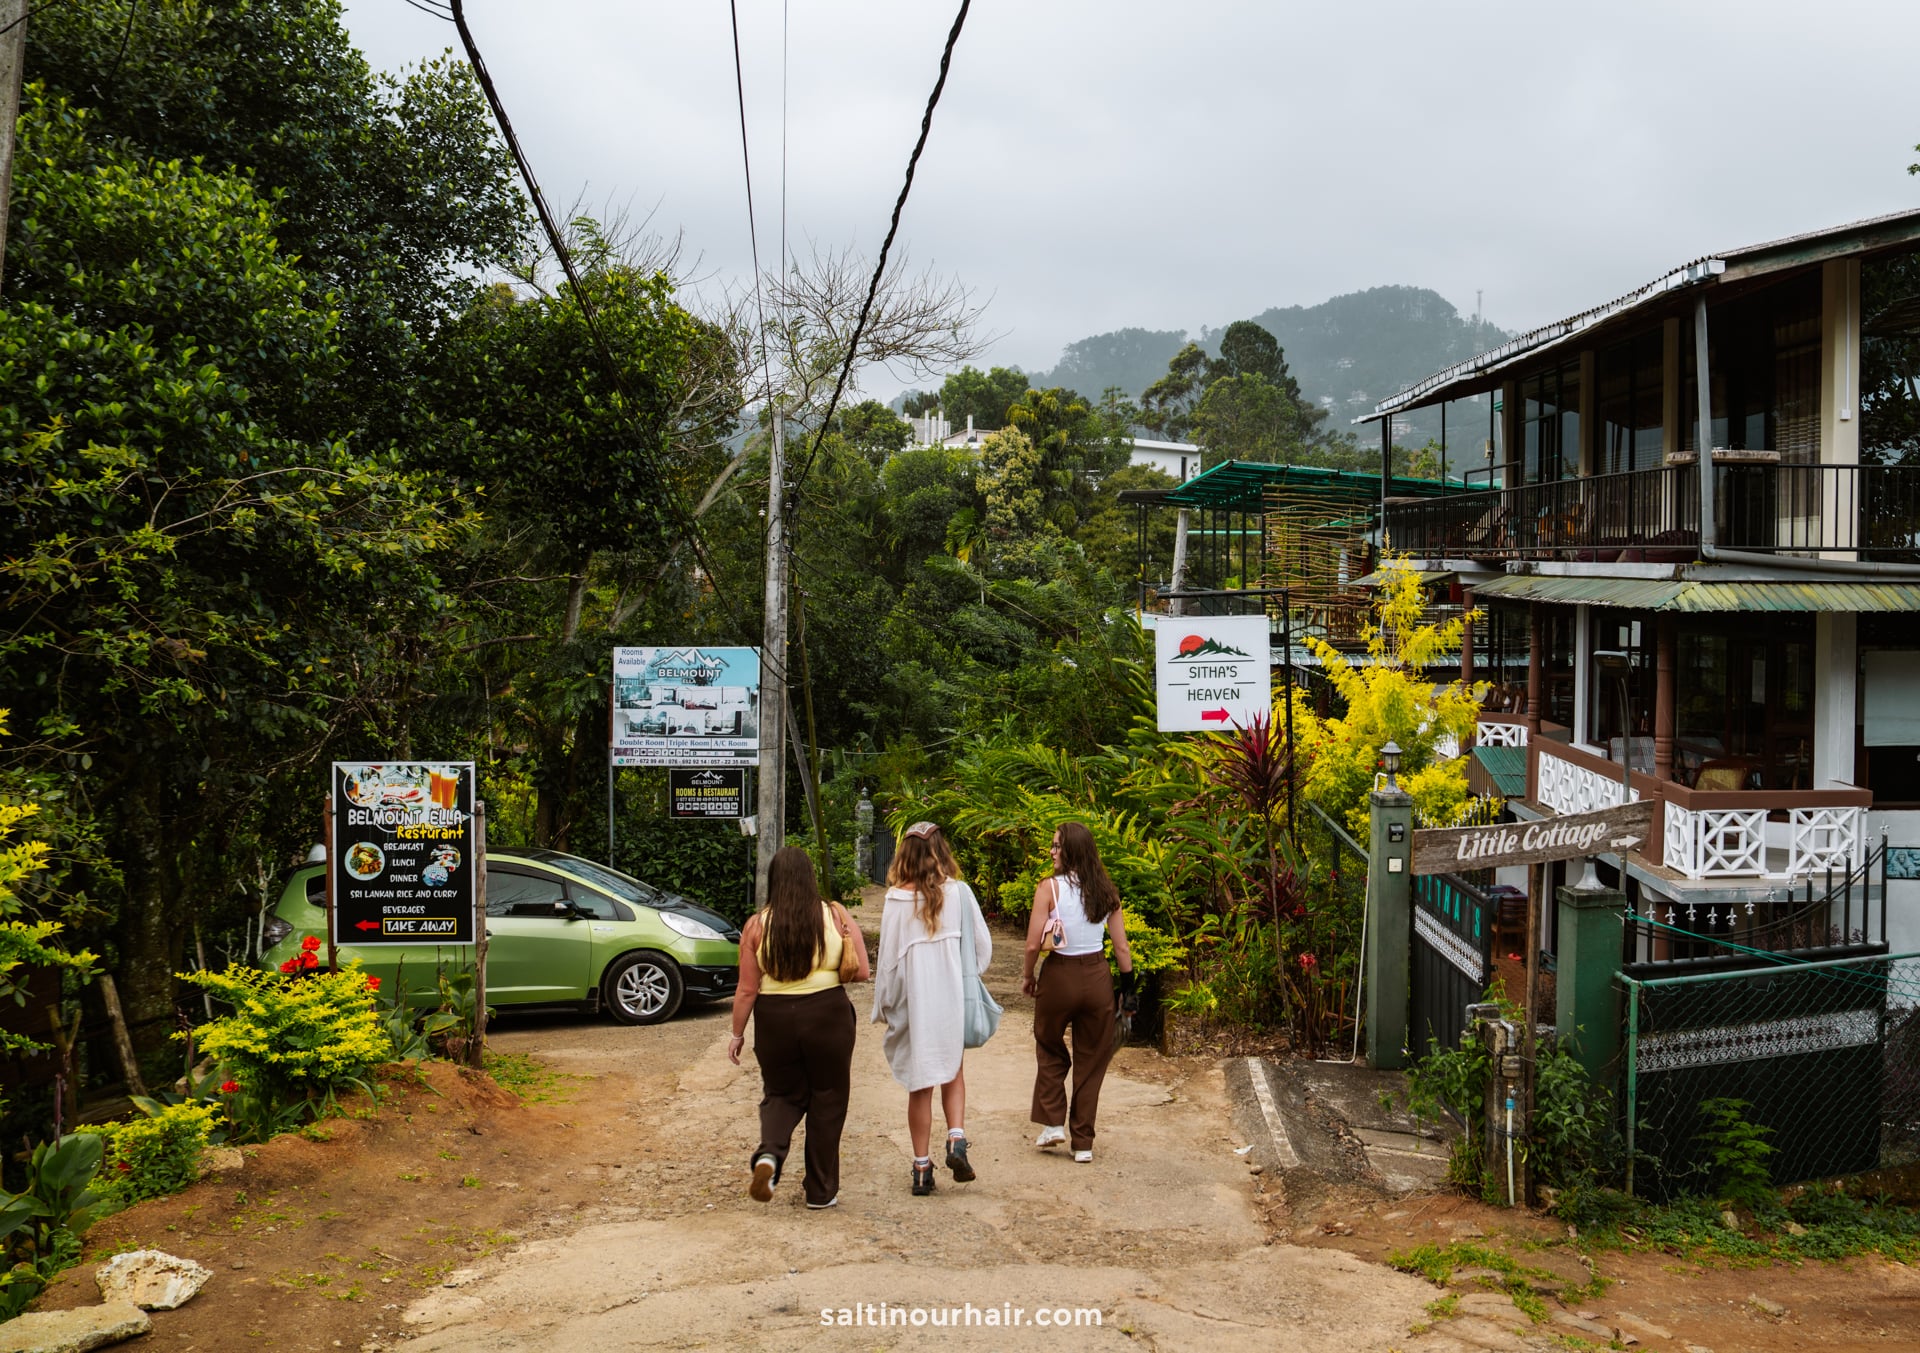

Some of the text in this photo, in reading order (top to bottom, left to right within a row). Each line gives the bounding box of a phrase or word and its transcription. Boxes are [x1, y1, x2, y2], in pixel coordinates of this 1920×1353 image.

[621, 648, 643, 656] Rooms
[618, 657, 646, 665] Available
[658, 669, 721, 678] BELMOUNT
[1189, 665, 1238, 679] SITHA'S
[1187, 688, 1240, 701] HEAVEN
[669, 739, 688, 747] Triple
[675, 787, 739, 797] ROOMS & RESTAURANT
[347, 809, 464, 826] BELMOUNT ELLA
[396, 824, 465, 840] Resturant
[1457, 821, 1607, 861] Little Cottage
[383, 842, 425, 851] BREAKFAST
[392, 858, 416, 867] LUNCH
[389, 874, 418, 883] DINNER
[350, 890, 458, 898] SRI LANKAN RICE AND CURRY
[382, 905, 426, 914] BEVERAGES
[385, 920, 455, 933] TAKE AWAY
